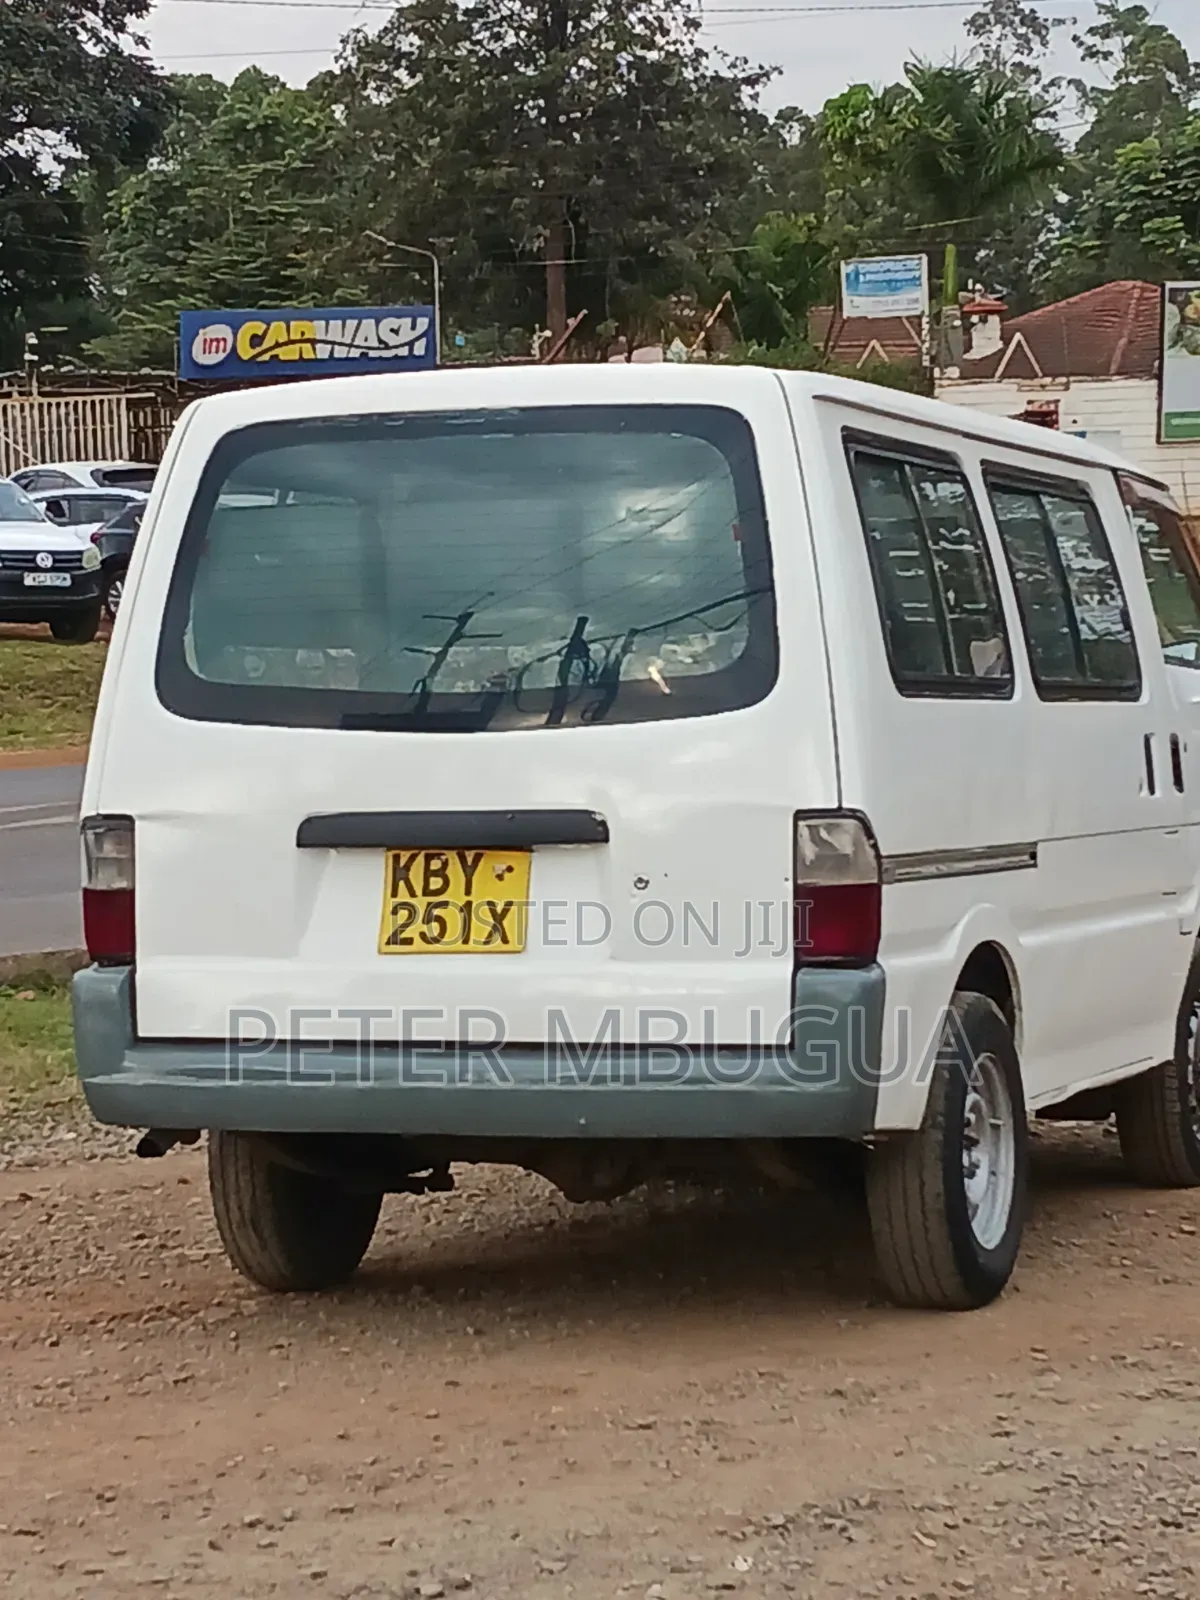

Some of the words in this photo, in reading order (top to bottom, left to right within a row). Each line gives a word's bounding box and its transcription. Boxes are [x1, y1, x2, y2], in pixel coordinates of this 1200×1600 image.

[236, 317, 429, 361] CARWASH
[391, 850, 485, 898] KBY
[385, 900, 514, 946] 251X
